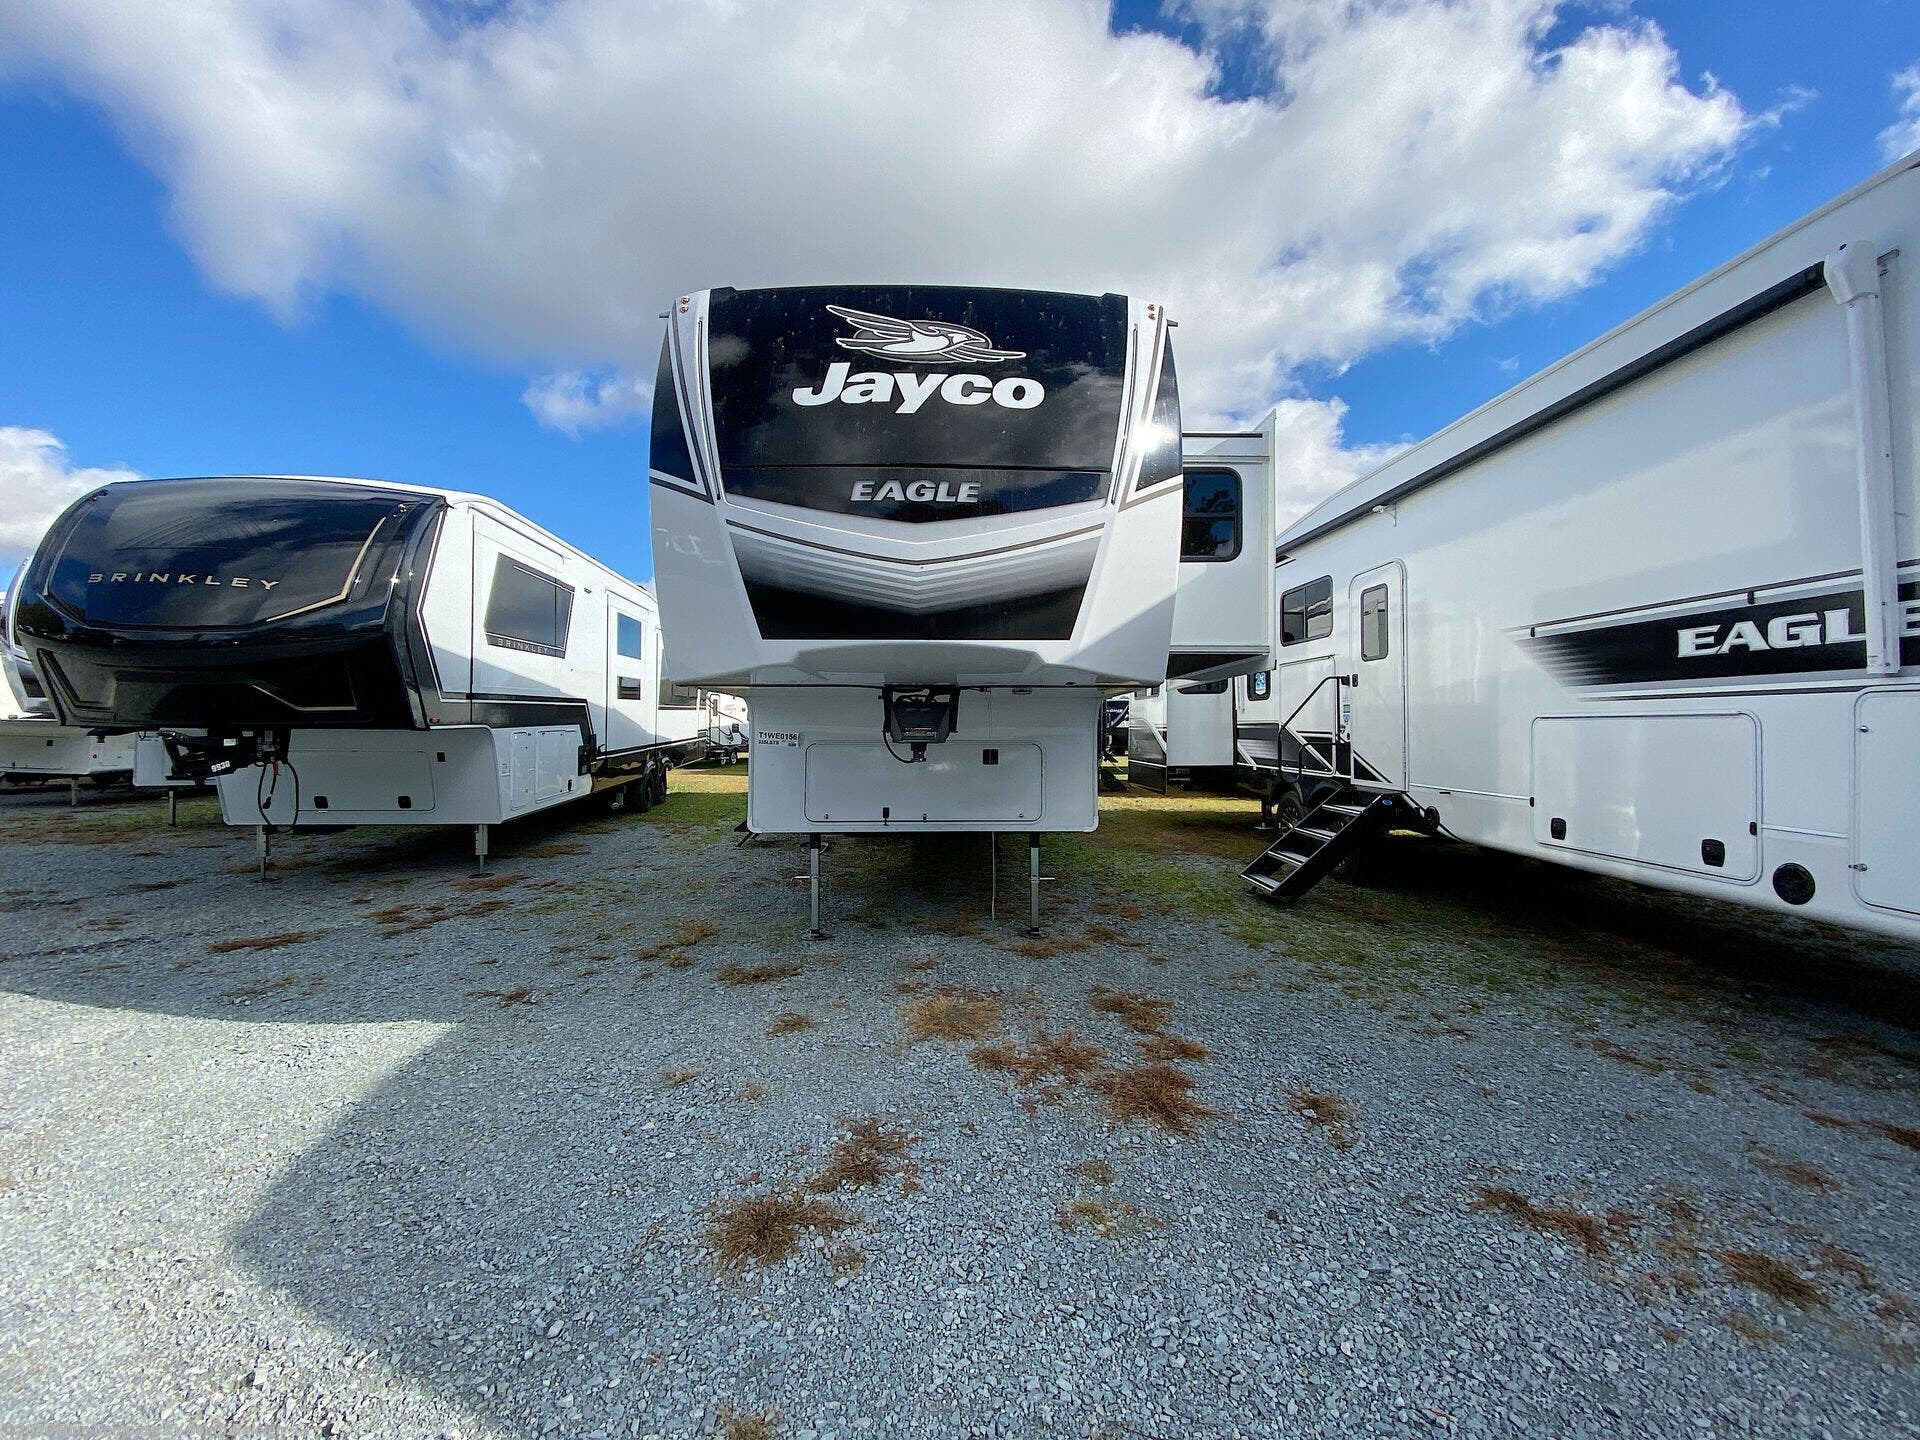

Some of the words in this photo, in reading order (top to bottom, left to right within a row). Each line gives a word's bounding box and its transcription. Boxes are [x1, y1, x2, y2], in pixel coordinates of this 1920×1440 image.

[792, 362, 1045, 414] Jayco
[850, 479, 981, 503] EAGLE
[88, 572, 280, 590] BRINKLEY
[497, 638, 549, 654] BRINKLEY
